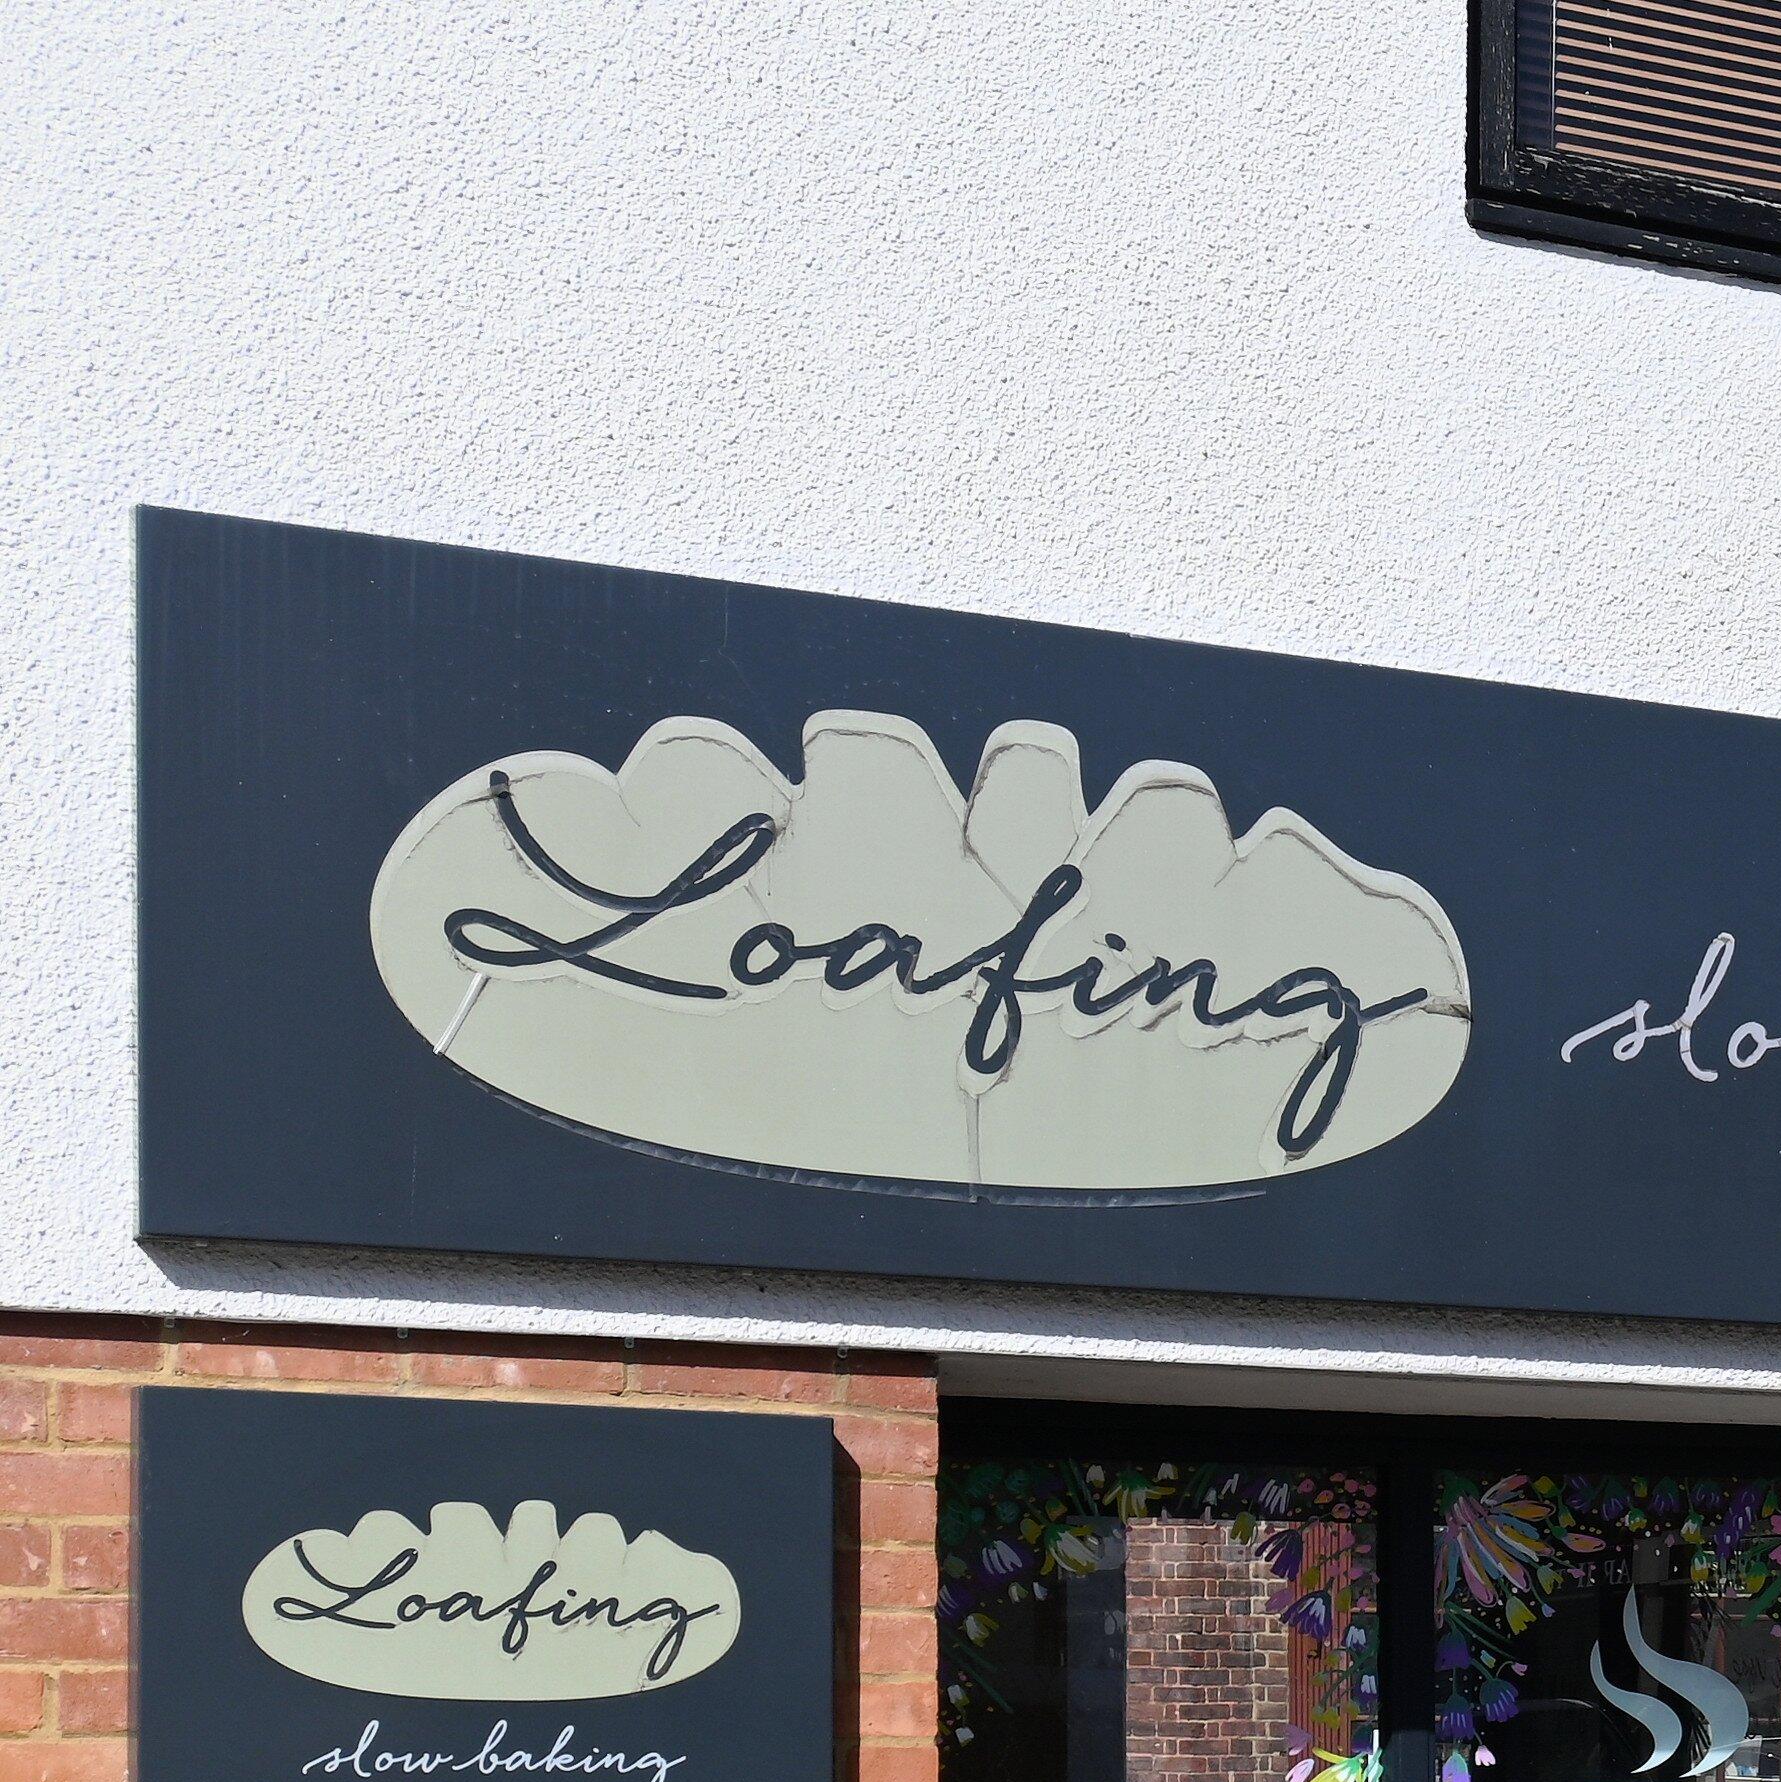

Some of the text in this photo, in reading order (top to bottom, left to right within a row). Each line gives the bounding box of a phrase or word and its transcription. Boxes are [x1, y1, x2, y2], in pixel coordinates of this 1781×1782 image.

[442, 769, 1428, 1155] Loafing
[272, 1538, 720, 1681] Loafing
[302, 1719, 453, 1776] slow
